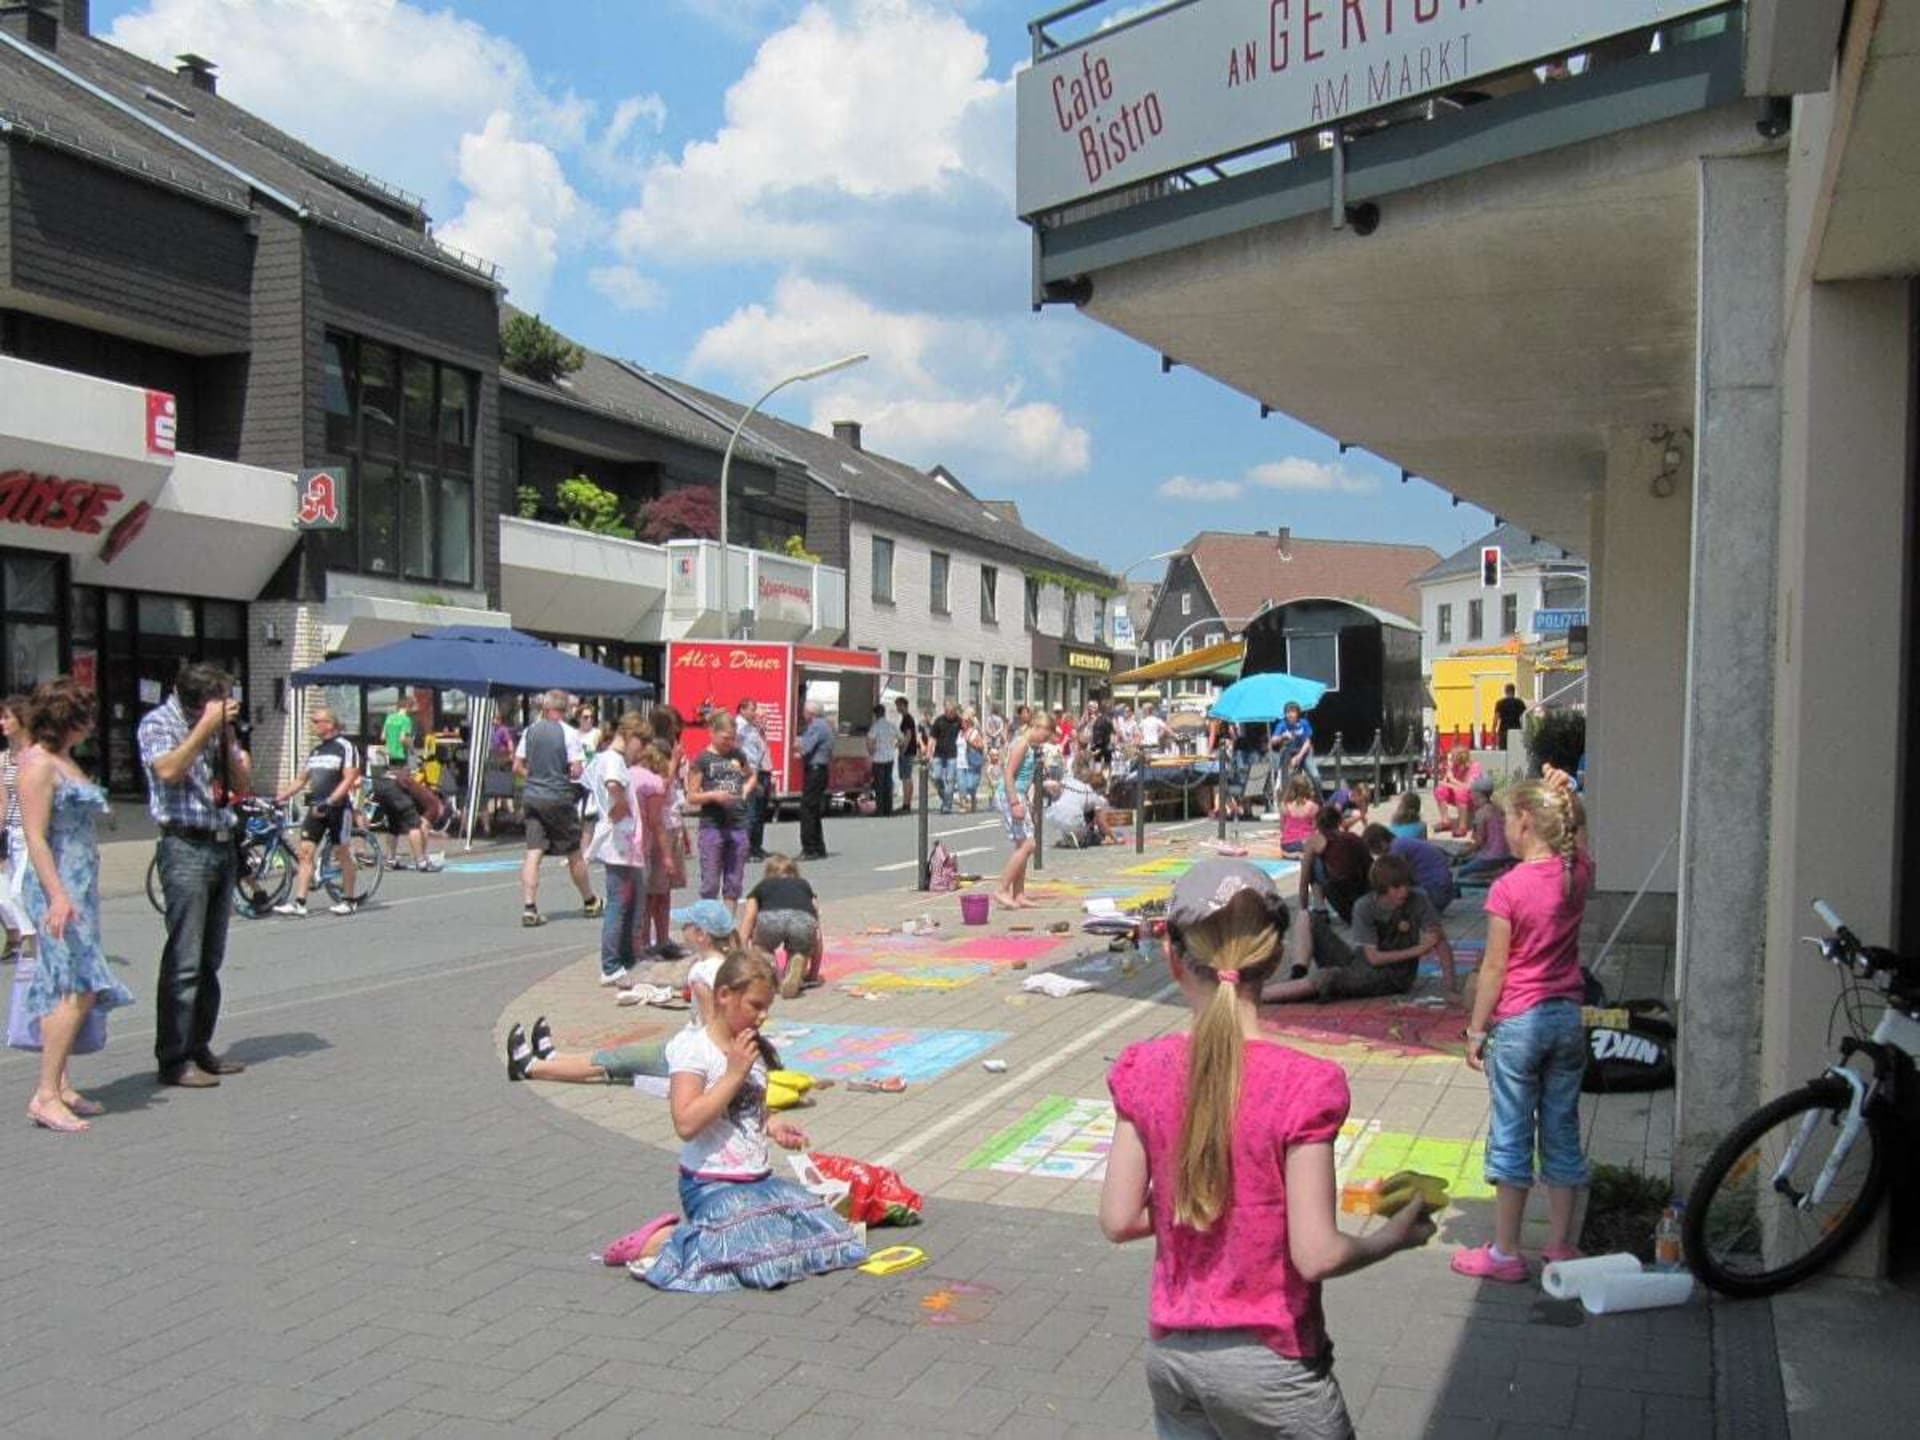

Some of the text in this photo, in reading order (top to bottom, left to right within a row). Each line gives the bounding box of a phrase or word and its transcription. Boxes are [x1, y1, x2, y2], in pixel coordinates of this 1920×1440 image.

[1053, 51, 1112, 132] Cafe
[1228, 41, 1257, 88] AN
[1311, 34, 1471, 122] AM MARKT
[1079, 92, 1162, 183] Bistro
[728, 650, 782, 669] Döner
[1591, 1028, 1660, 1066] NIKE
